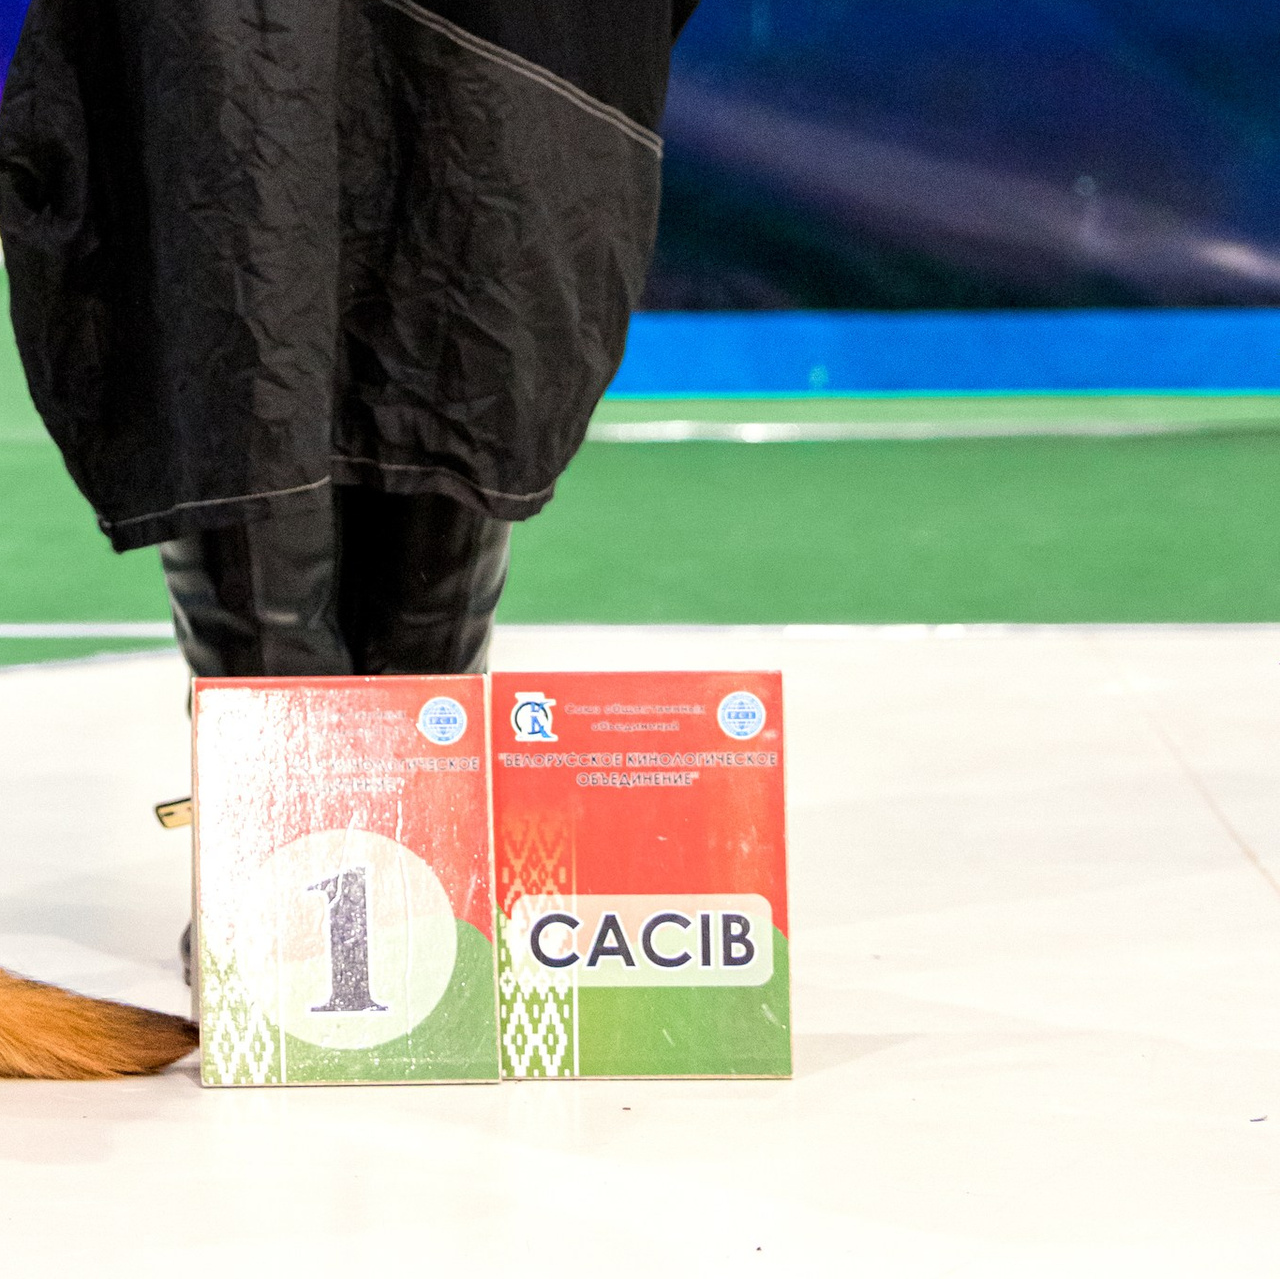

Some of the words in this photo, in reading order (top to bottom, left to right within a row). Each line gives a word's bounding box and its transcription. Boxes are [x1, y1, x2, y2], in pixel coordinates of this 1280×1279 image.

[626, 752, 778, 767] КИНОЛОГИЧЕСКОЕ
[307, 866, 389, 1012] 1
[530, 913, 757, 968] CACIB
